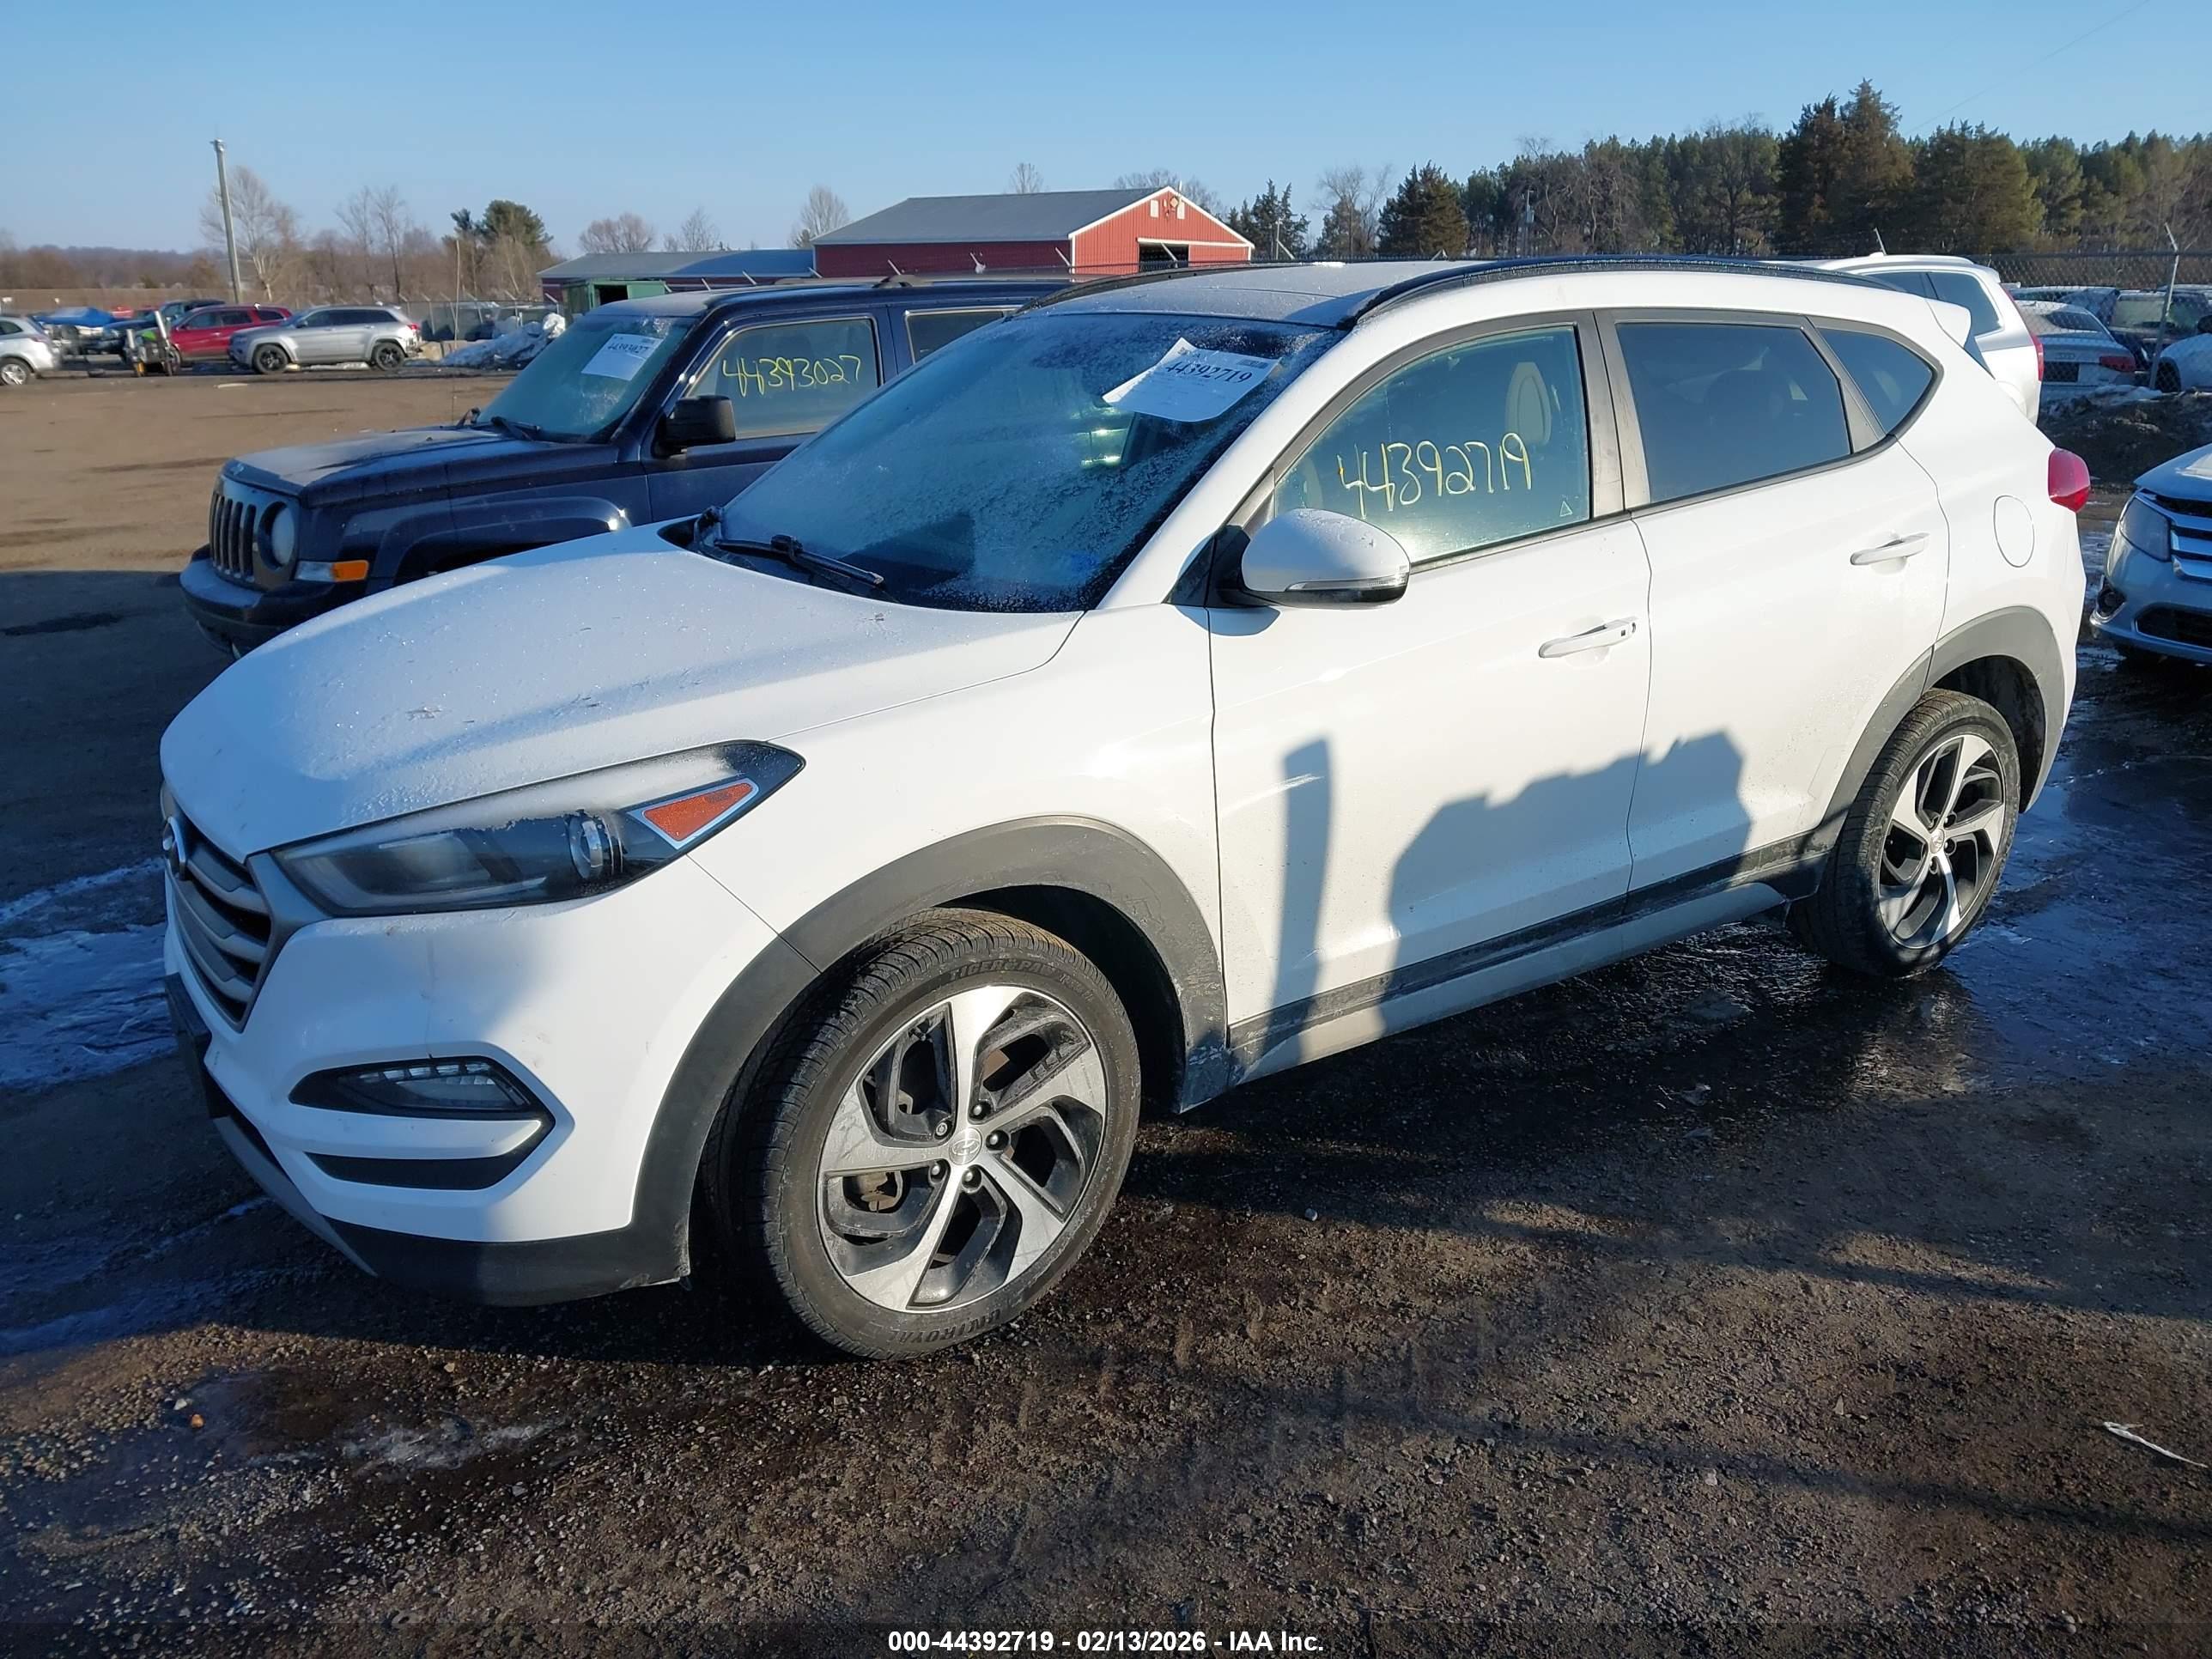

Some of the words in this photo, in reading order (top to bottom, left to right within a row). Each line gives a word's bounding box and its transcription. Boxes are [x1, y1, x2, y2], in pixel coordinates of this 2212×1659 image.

[722, 355, 861, 397] 44393027
[1165, 362, 1253, 383] 44392719
[1337, 433, 1532, 520] 44392719
[949, 960, 1000, 981] TIGER
[887, 1309, 1000, 1343] UNIROYAL
